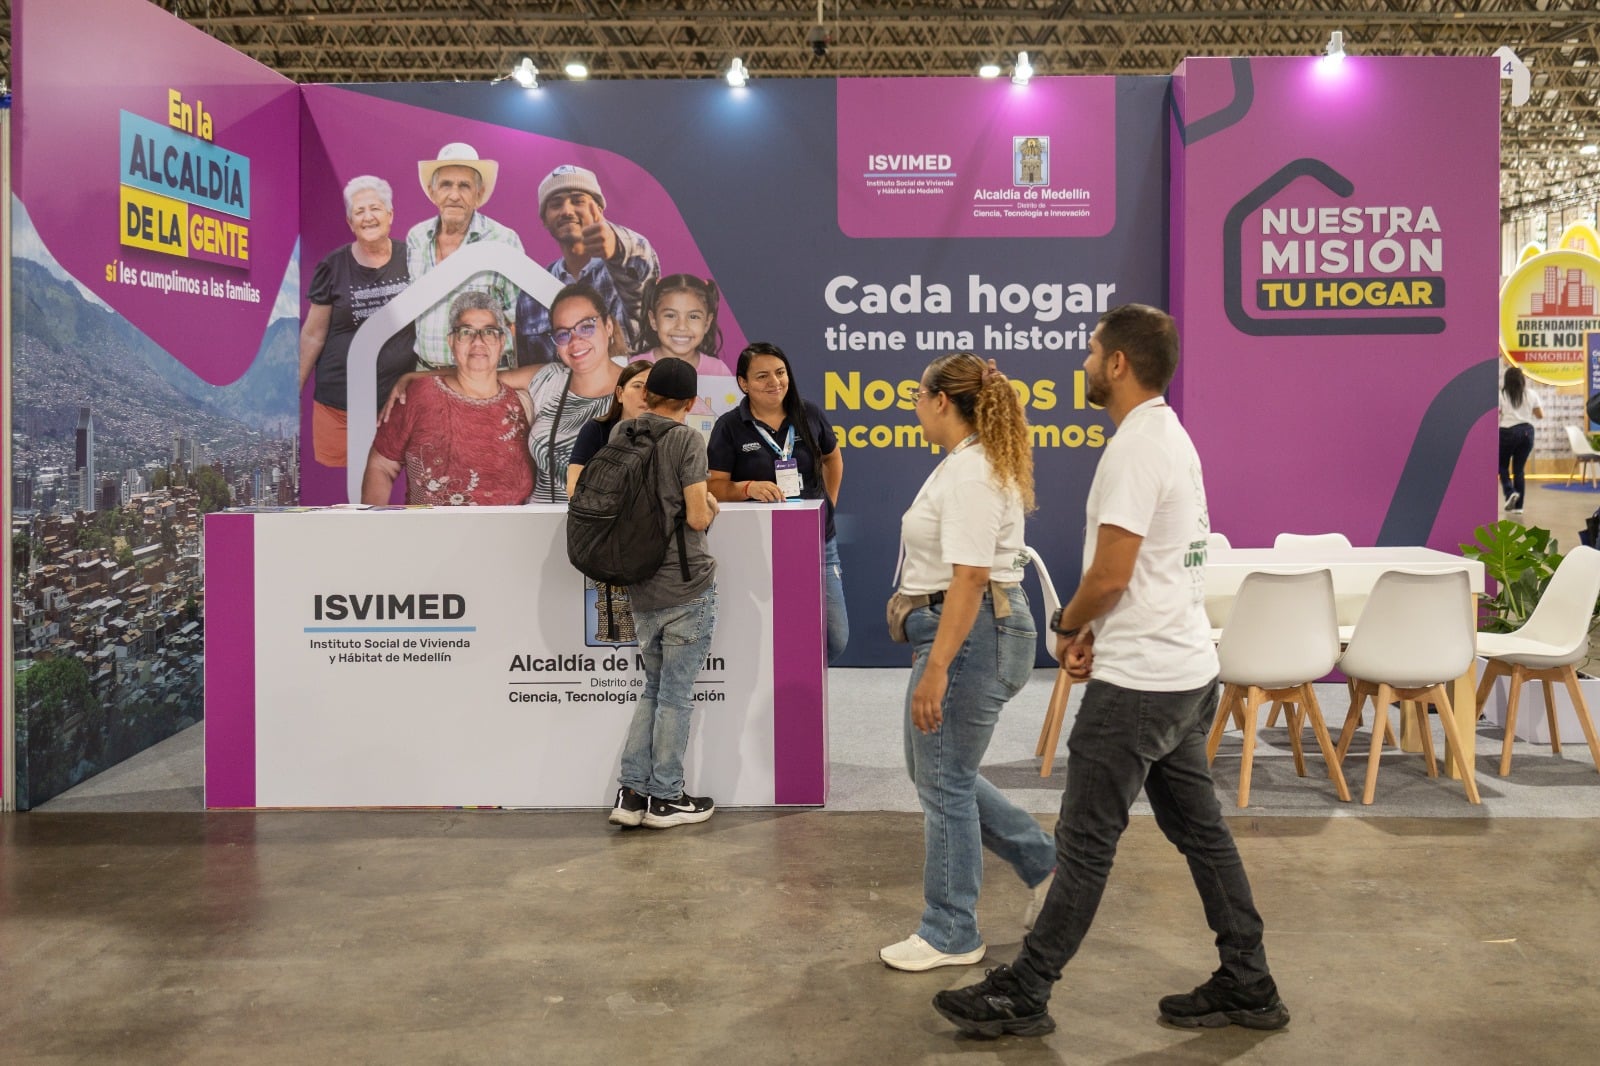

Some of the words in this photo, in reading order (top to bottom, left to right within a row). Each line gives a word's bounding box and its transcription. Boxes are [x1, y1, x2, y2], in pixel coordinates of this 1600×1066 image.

[168, 88, 193, 133] En
[197, 100, 213, 141] la
[129, 133, 244, 208] ALCALDÍA
[869, 154, 952, 171] ISVIMED
[973, 188, 1020, 200] Alcaldía
[1023, 189, 1038, 200] de
[1041, 188, 1090, 200] Medellín
[973, 209, 1002, 218] Ciencia,
[1004, 209, 1042, 218] Tecnología
[1050, 209, 1090, 217] Innovación
[1262, 206, 1441, 234] NUESTRA
[127, 201, 153, 241] DE
[158, 209, 182, 247] LA
[190, 213, 248, 260] GENTE
[1262, 228, 1443, 274] MISIÓN
[105, 259, 117, 282] sí
[120, 261, 137, 286] les
[140, 269, 200, 294] cumplimos
[202, 280, 208, 295] a
[211, 277, 224, 299] las
[226, 279, 260, 303] familias
[1262, 282, 1306, 307] TU
[1315, 281, 1433, 307] HOGAR
[824, 274, 951, 314] Cada
[968, 274, 1116, 322] hogar
[825, 323, 906, 351] tiene
[916, 330, 974, 351] una
[984, 322, 1095, 351] histori
[1518, 333, 1548, 347] DEL
[314, 594, 465, 620] ISVIMED
[310, 639, 361, 649] Instituto
[364, 639, 399, 648] Social
[403, 639, 417, 648] de
[420, 638, 470, 648] Vivienda
[329, 655, 336, 664] y
[339, 653, 382, 662] Hábitat
[386, 653, 400, 662] de
[403, 652, 451, 662] Medellín
[509, 654, 596, 672] Alcaldía
[602, 654, 628, 671] de
[590, 677, 627, 687] Distrito
[629, 677, 643, 687] de
[509, 691, 561, 704] Ciencia,
[565, 690, 637, 704] Tecnología
